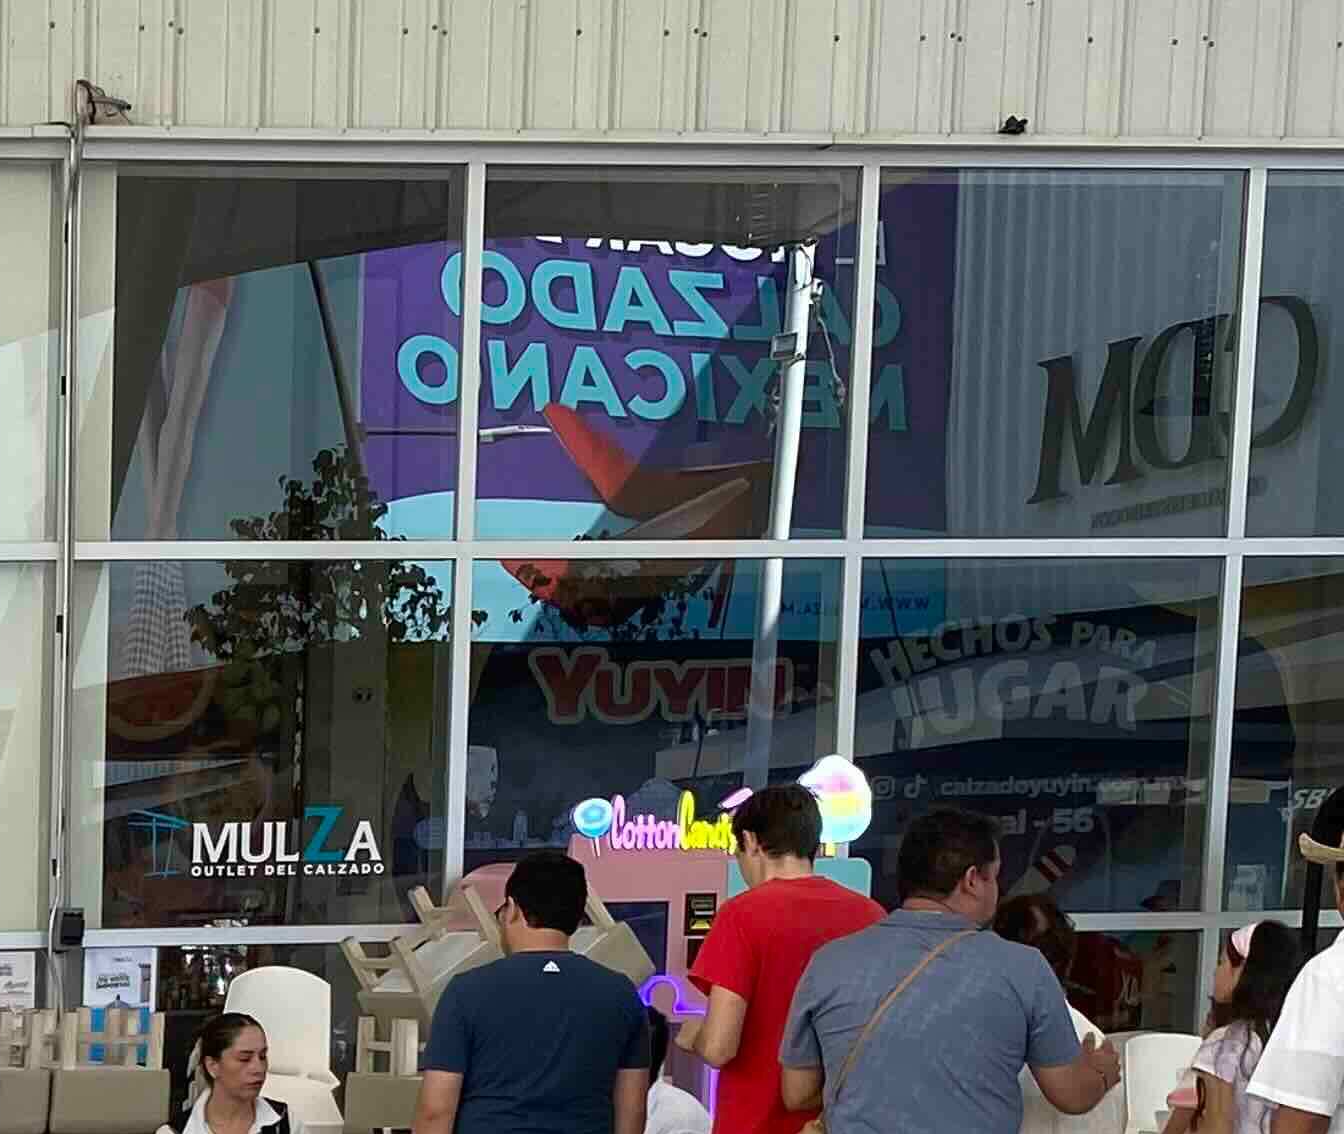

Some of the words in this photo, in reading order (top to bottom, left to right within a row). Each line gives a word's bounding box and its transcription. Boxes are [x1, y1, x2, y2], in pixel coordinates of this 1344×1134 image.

[870, 616, 1054, 684] HECHOS
[191, 805, 384, 863] MULZA
[191, 863, 257, 877] OUTLET
[264, 862, 297, 877] DEL
[303, 861, 386, 877] CALZADO
